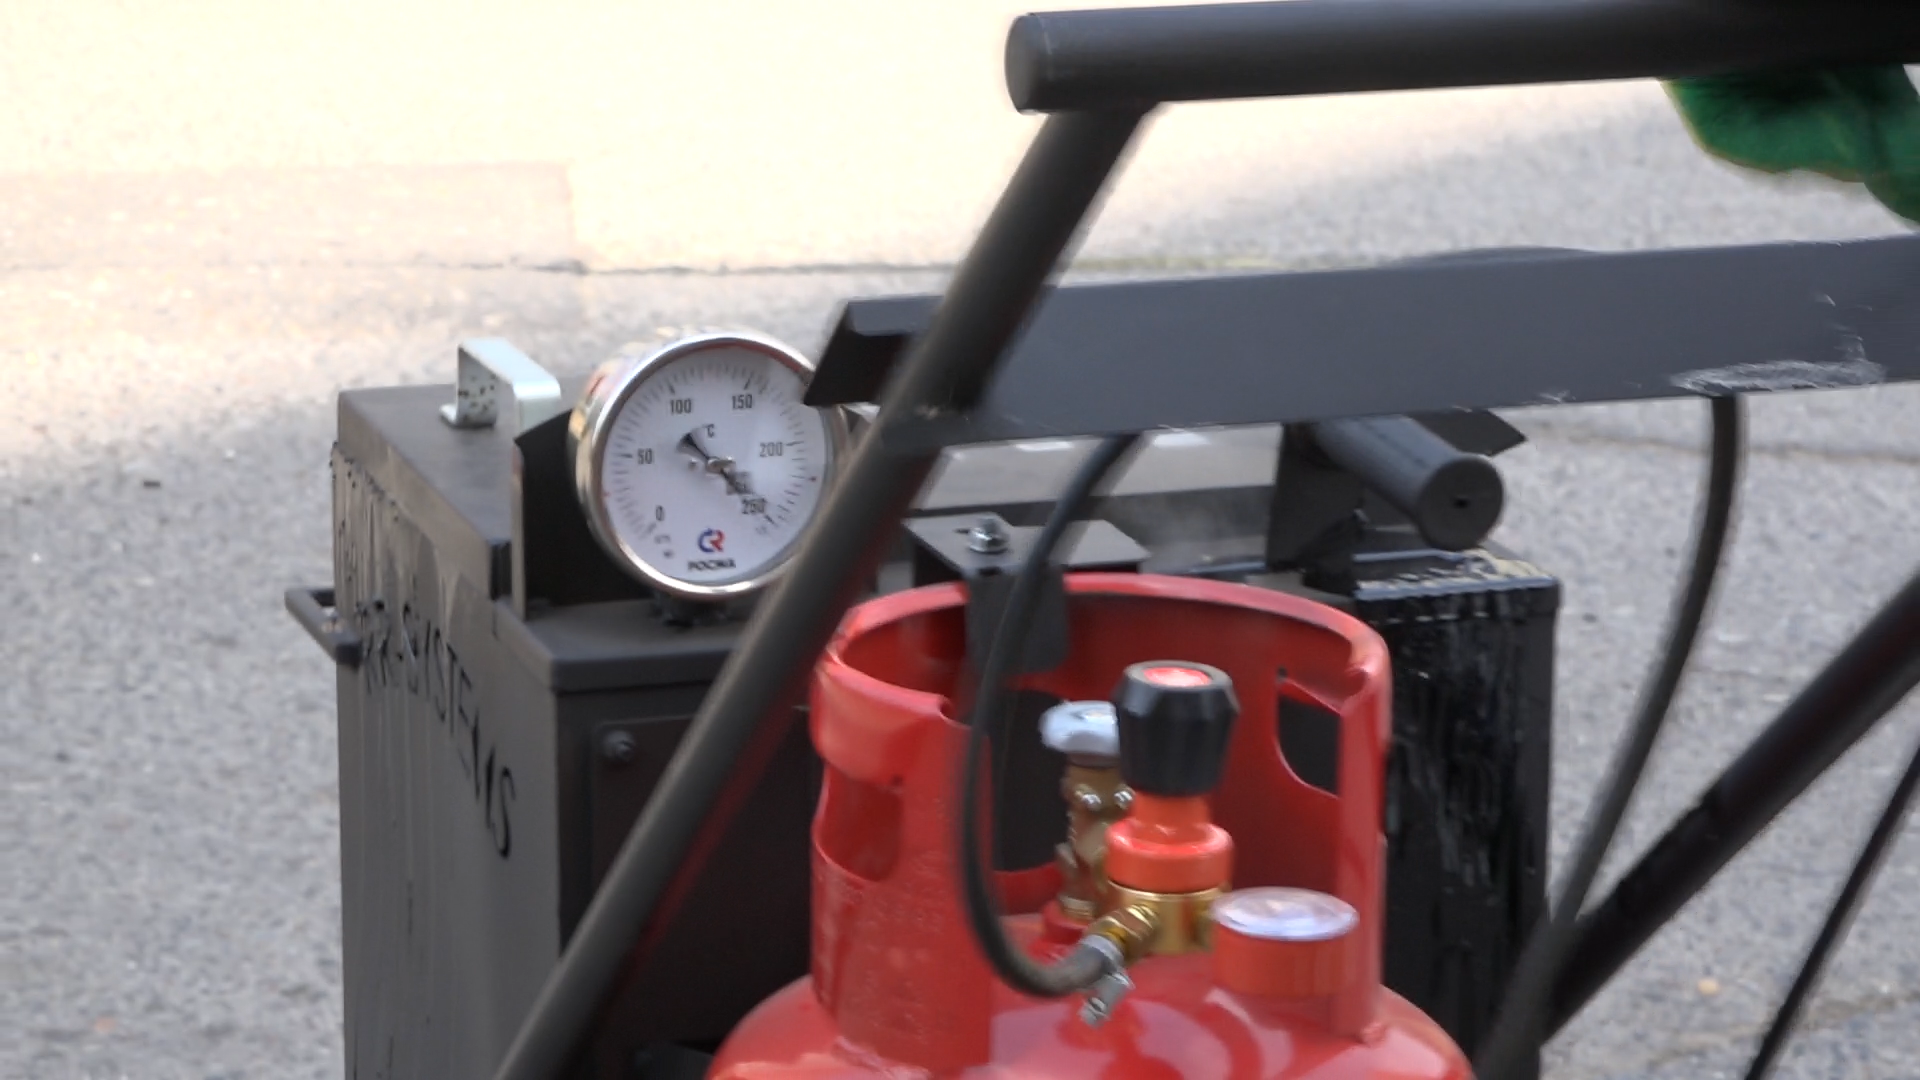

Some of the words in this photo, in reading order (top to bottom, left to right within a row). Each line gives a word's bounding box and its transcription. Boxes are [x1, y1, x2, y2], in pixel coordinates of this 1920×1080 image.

[669, 398, 692, 415] 100
[731, 394, 753, 410] 150
[637, 448, 653, 465] 50
[759, 441, 784, 457] 200
[655, 505, 665, 522] 0
